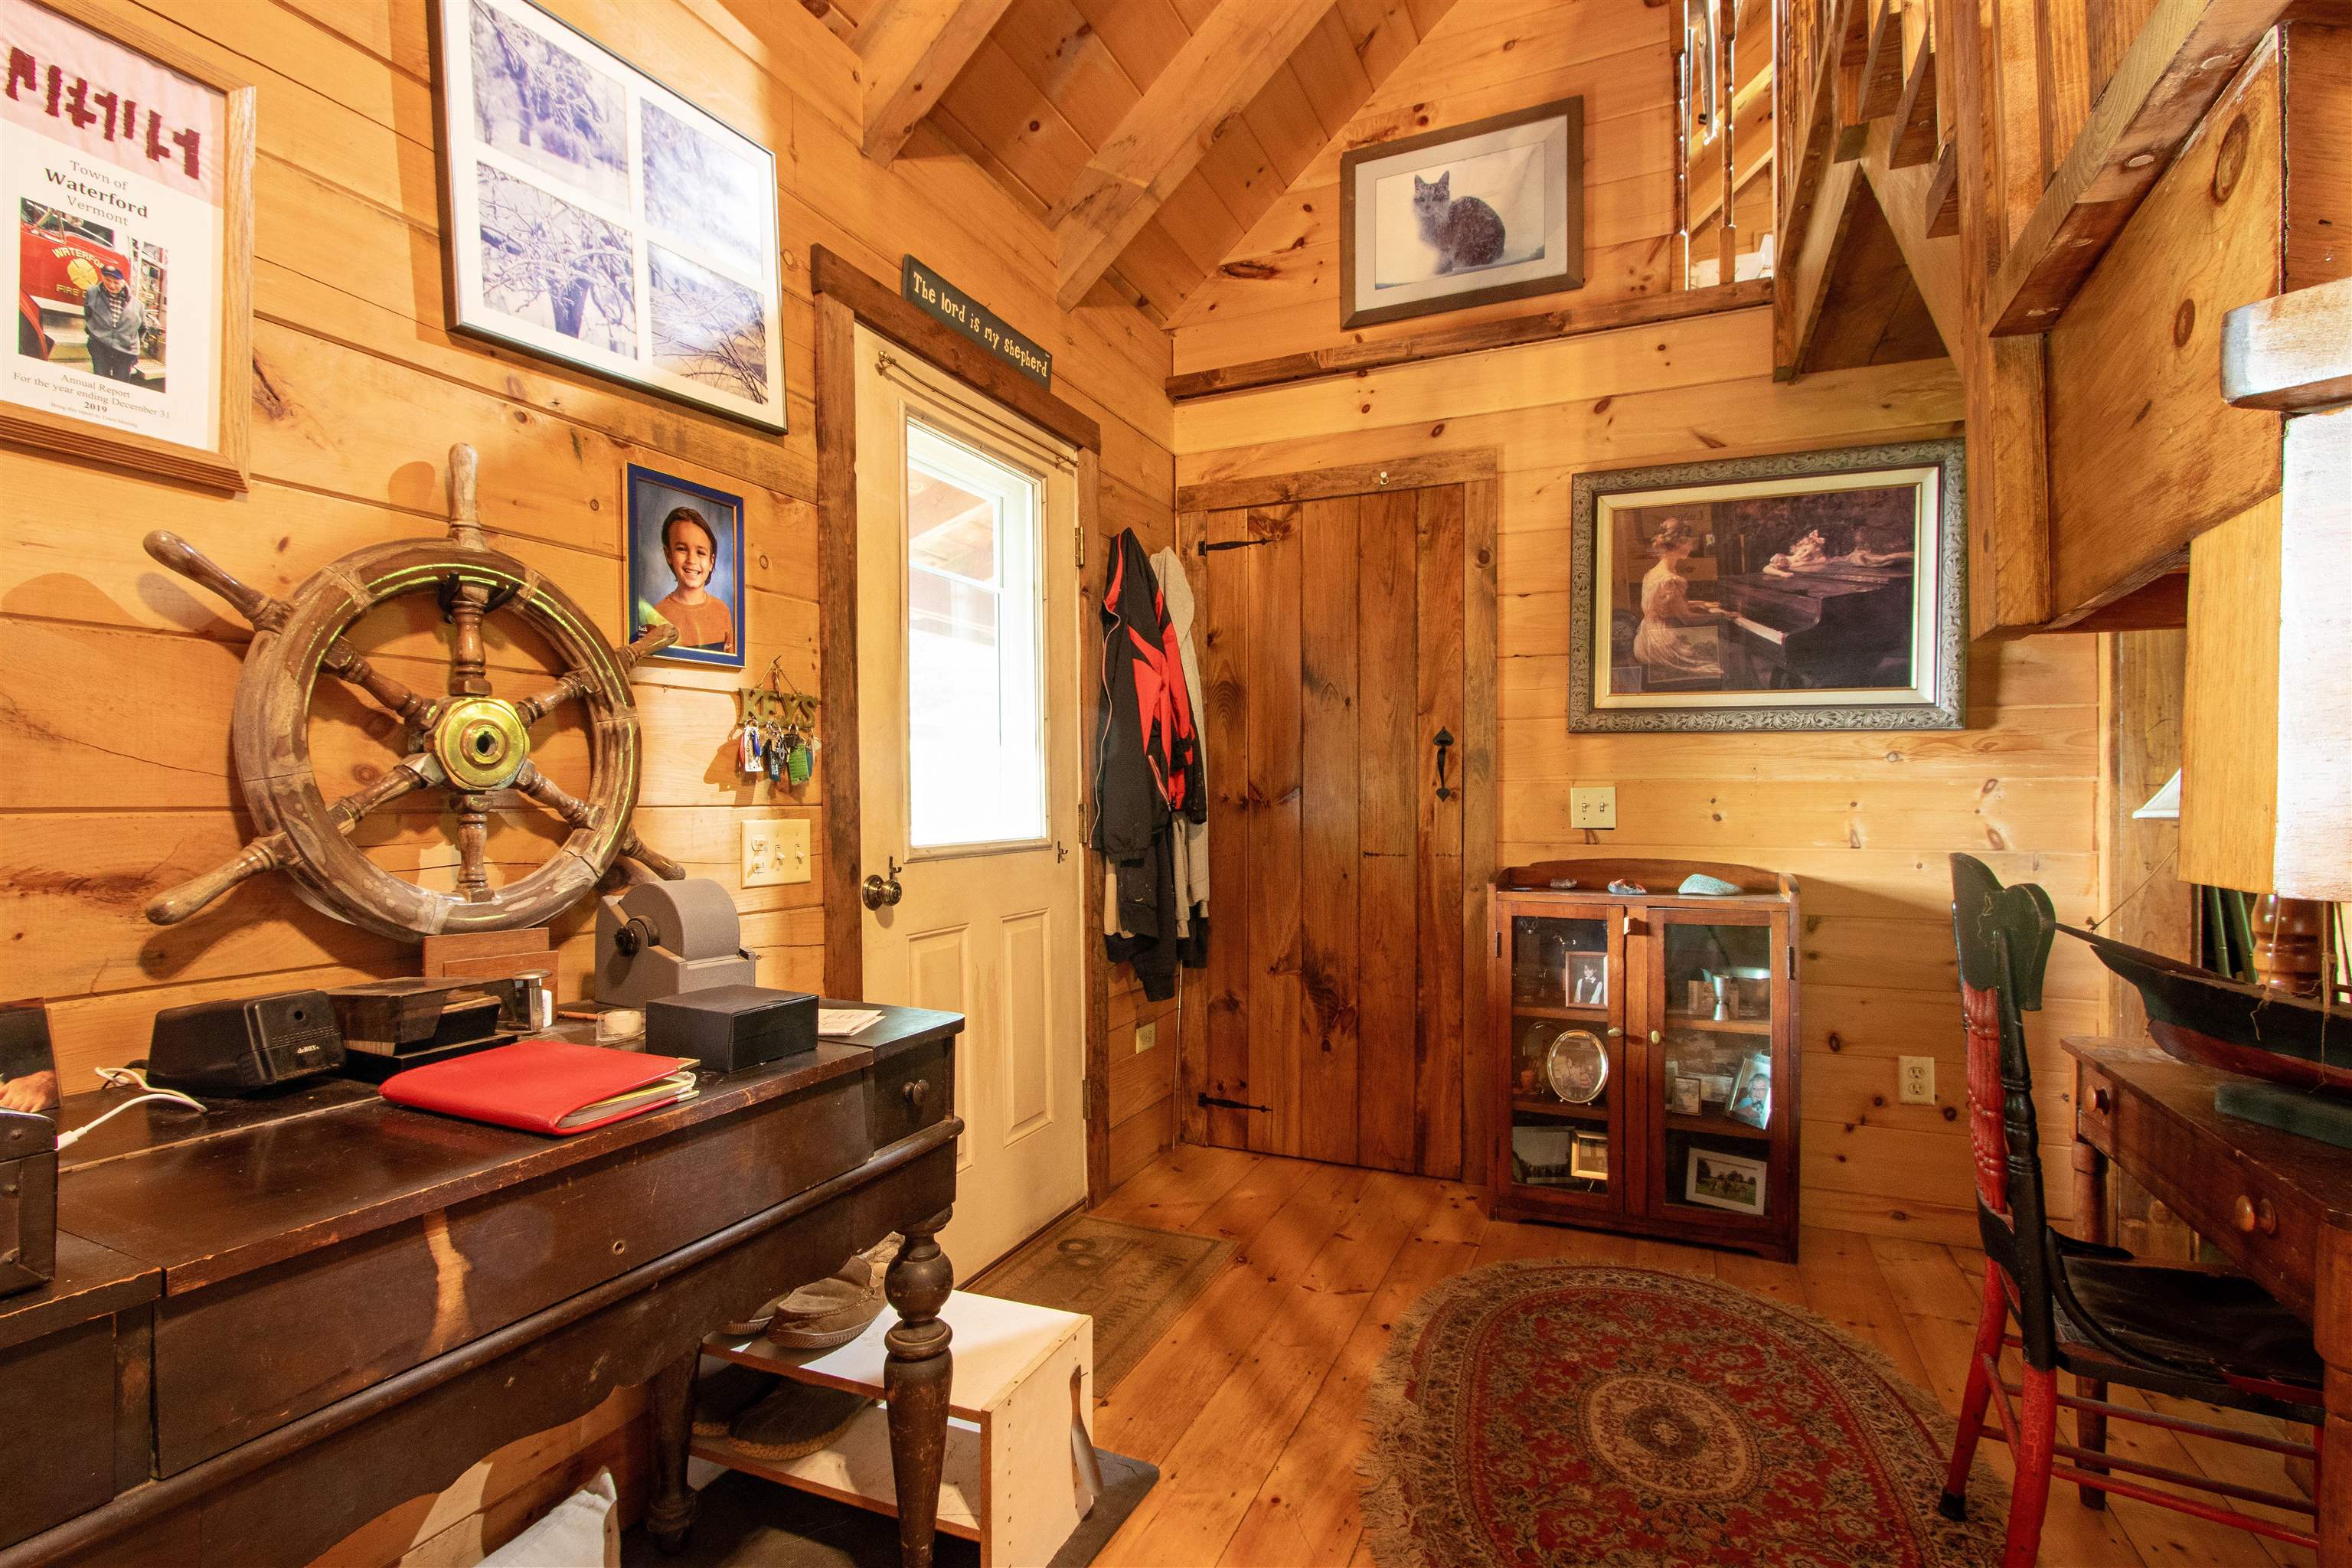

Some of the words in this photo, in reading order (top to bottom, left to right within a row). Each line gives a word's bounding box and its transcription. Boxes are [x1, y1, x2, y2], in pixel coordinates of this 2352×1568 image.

[70, 159, 110, 185] Town
[114, 181, 129, 191] of
[44, 168, 149, 218] Waterford
[67, 194, 129, 226] Vermont
[56, 283, 80, 296] FIRE
[913, 270, 936, 304] The
[941, 292, 966, 323] lord
[970, 313, 980, 332] is
[984, 326, 1000, 350] my
[1004, 338, 1047, 377] shepherd
[13, 372, 31, 384] For
[34, 378, 50, 388] the
[52, 384, 74, 394] year
[77, 390, 109, 404] ending
[112, 397, 157, 416] December
[159, 409, 170, 419] 31
[61, 374, 96, 389] Annual
[99, 383, 131, 398] Report
[84, 401, 108, 413] 2019
[738, 688, 818, 730] KEYS
